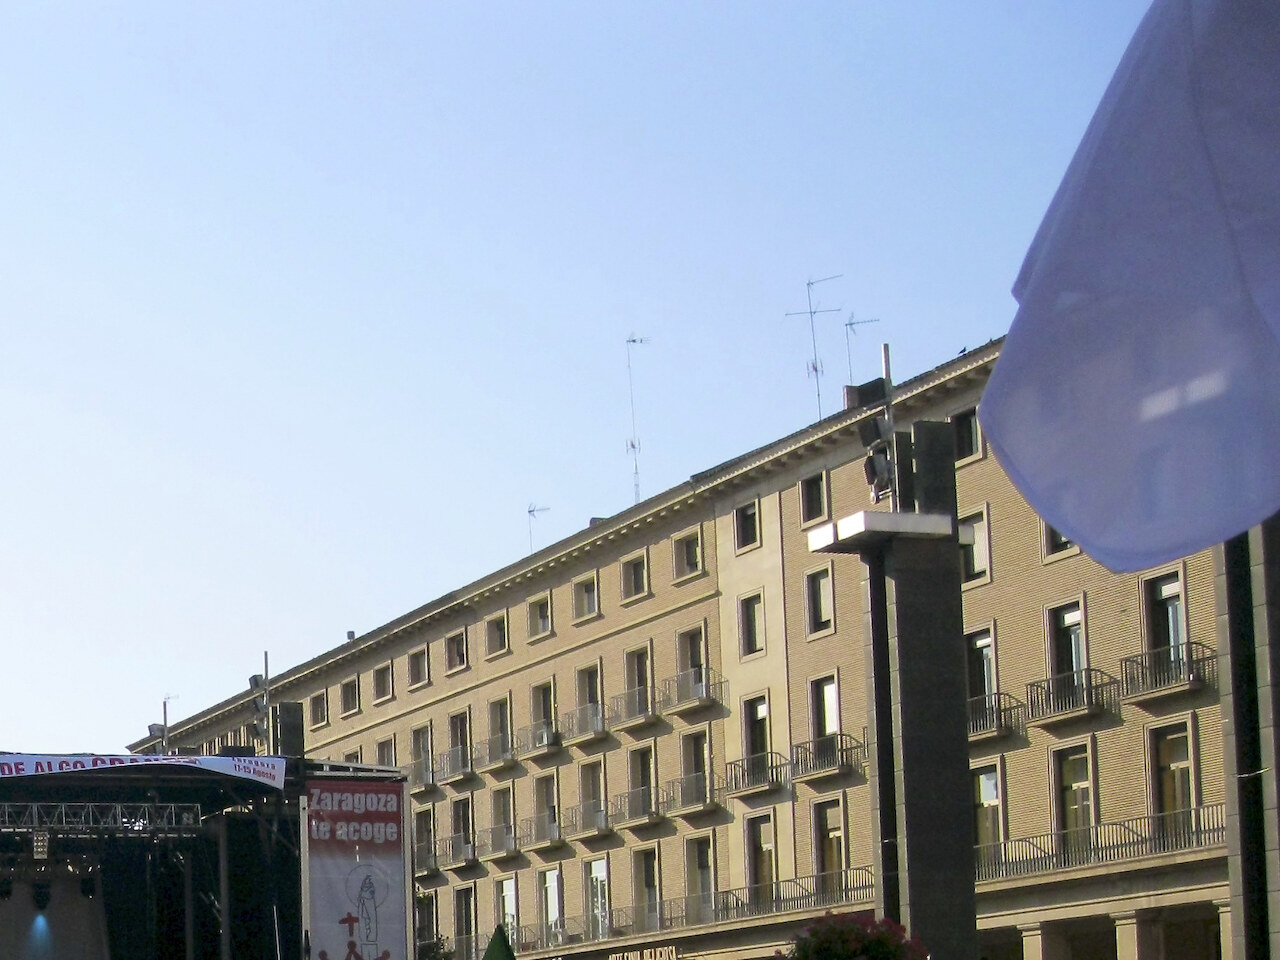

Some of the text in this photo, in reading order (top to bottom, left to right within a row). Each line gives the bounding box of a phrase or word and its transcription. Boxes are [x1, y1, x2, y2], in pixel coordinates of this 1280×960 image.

[0, 761, 25, 776] DE
[309, 788, 398, 814] Zaragoza
[312, 820, 398, 844] te acoge
